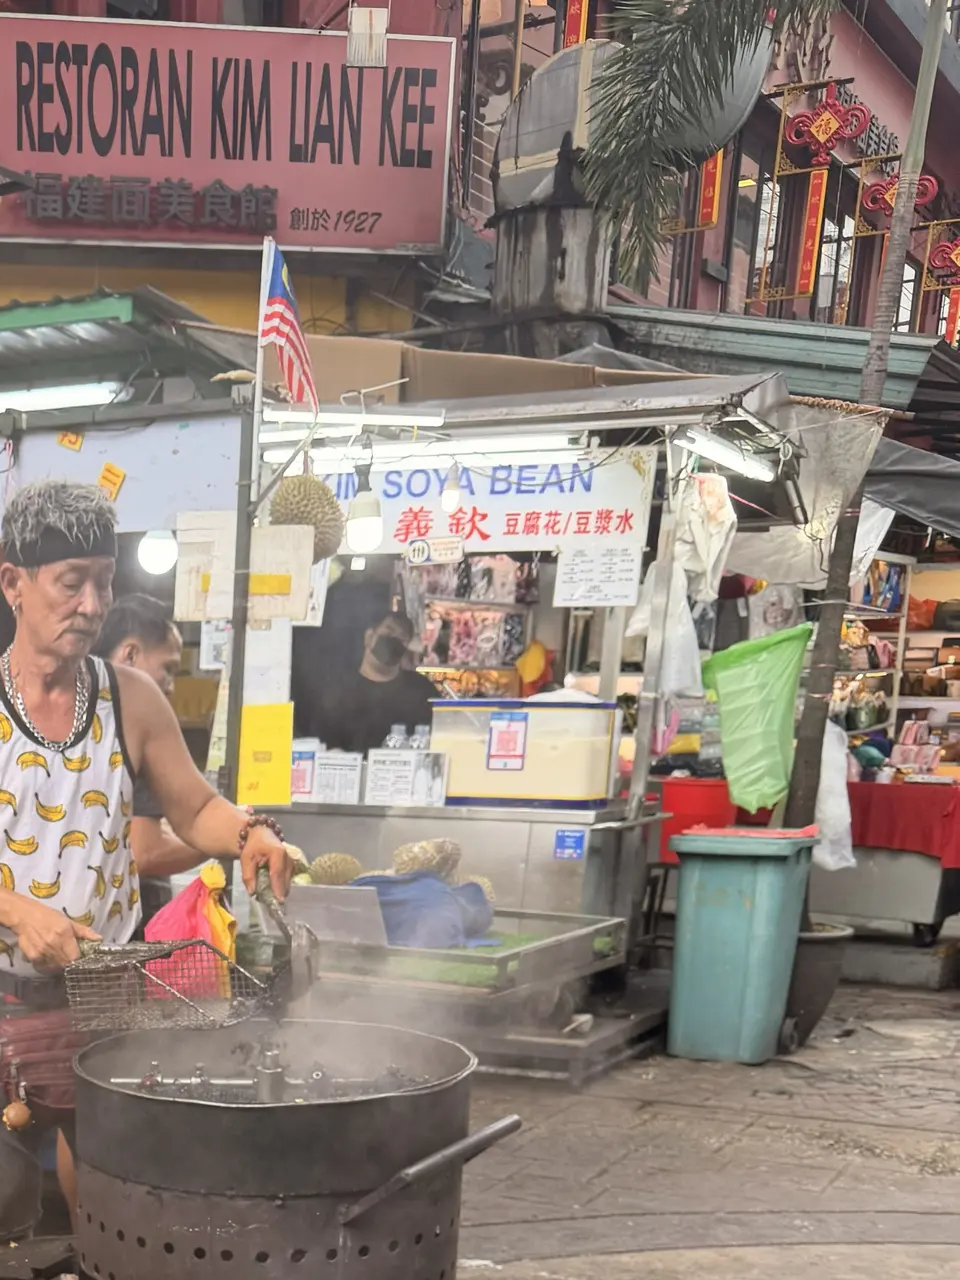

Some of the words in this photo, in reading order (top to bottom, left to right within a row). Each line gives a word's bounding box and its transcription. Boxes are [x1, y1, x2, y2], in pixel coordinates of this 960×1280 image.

[15, 40, 193, 158] RESTORAN
[210, 56, 272, 162] KIM
[288, 61, 364, 165] LIAN
[378, 66, 439, 168] KEE
[22, 170, 279, 231] 福建面美食館
[322, 472, 358, 500] IM
[382, 466, 476, 499] SOYA
[489, 461, 595, 496] BEAN
